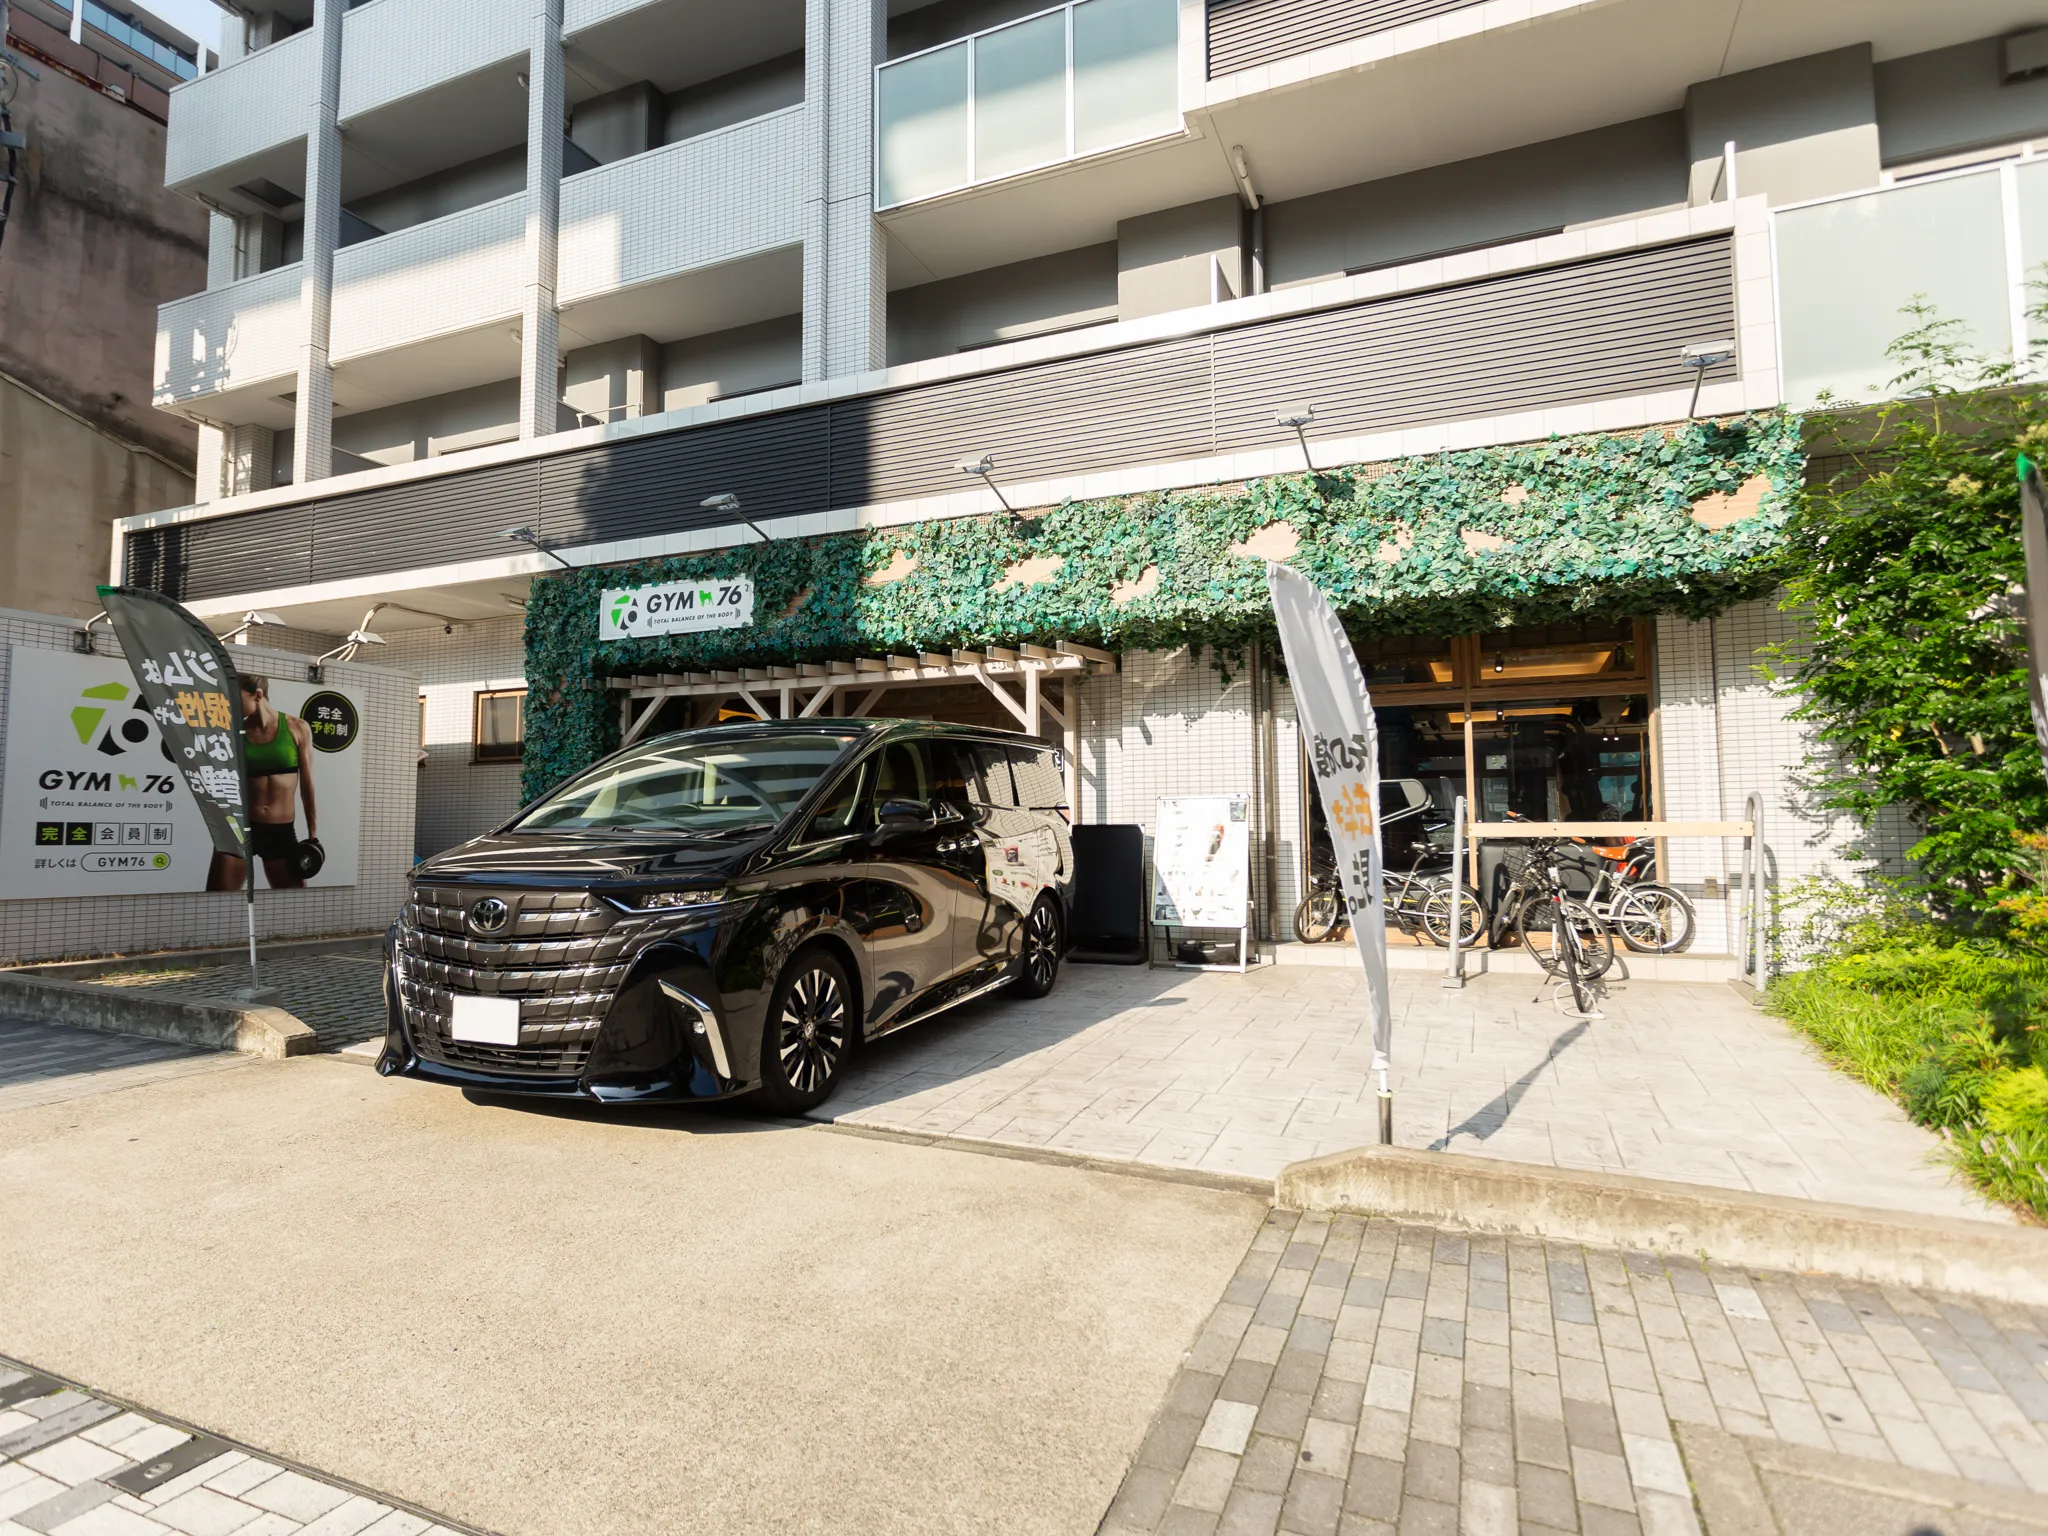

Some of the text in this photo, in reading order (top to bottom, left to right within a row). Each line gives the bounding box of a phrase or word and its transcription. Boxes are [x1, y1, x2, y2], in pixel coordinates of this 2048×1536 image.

[646, 585, 742, 614] GYM 76
[653, 617, 670, 625] TOTAL
[671, 615, 696, 623] BALANCE
[317, 706, 343, 721] 完全
[311, 721, 348, 737] 予約制
[38, 769, 175, 795] GYM 76
[41, 826, 167, 841] 完全会員制
[34, 856, 146, 869] 詳しくは GYM76
